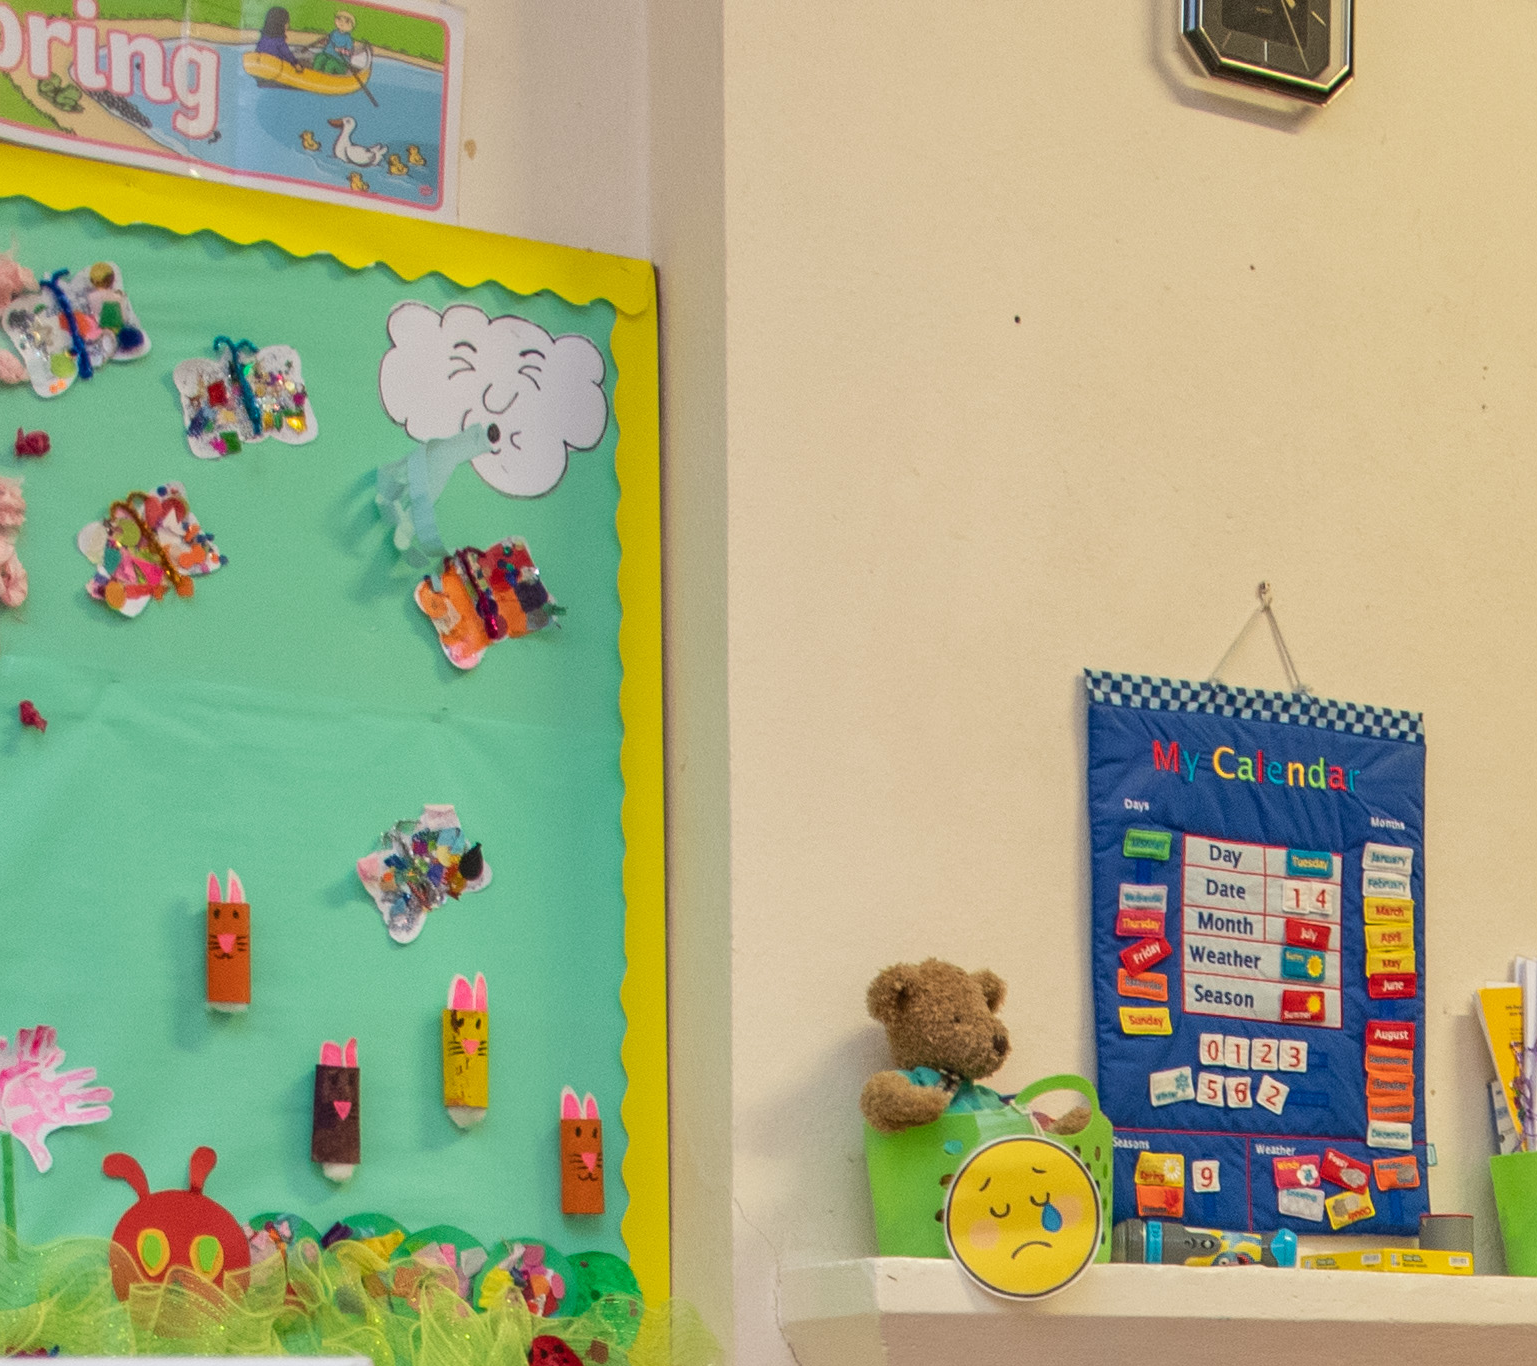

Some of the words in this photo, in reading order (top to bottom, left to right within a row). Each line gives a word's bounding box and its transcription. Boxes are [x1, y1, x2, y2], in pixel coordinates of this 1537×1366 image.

[1152, 740, 1200, 782] My
[1213, 746, 1360, 793] Calendar
[1124, 798, 1150, 812] Days
[1370, 816, 1406, 830] Months
[1209, 844, 1242, 869] Day
[1291, 855, 1329, 872] Tuesday
[1371, 851, 1407, 866] January
[1206, 878, 1246, 900] Date
[1368, 877, 1407, 892] February
[1375, 905, 1404, 917] March
[1122, 918, 1161, 931] Thursday
[1198, 911, 1254, 936] Month
[1300, 927, 1318, 943] July
[1381, 932, 1402, 945] April
[1132, 941, 1162, 965] Friday
[1189, 945, 1262, 970] Weather
[1382, 959, 1402, 971] May
[1382, 980, 1405, 992] June
[1194, 984, 1255, 1009] Season
[1128, 1015, 1164, 1028] Sunday
[1374, 1028, 1409, 1042] August
[1207, 1040, 1219, 1061] 0
[1261, 1043, 1272, 1064] 2
[1289, 1046, 1301, 1068] 3
[1207, 1079, 1218, 1100] 5
[1265, 1084, 1281, 1107] 2
[1113, 1136, 1150, 1150] Seasons
[1255, 1143, 1297, 1156] Weather
[1201, 1167, 1213, 1188] 9
